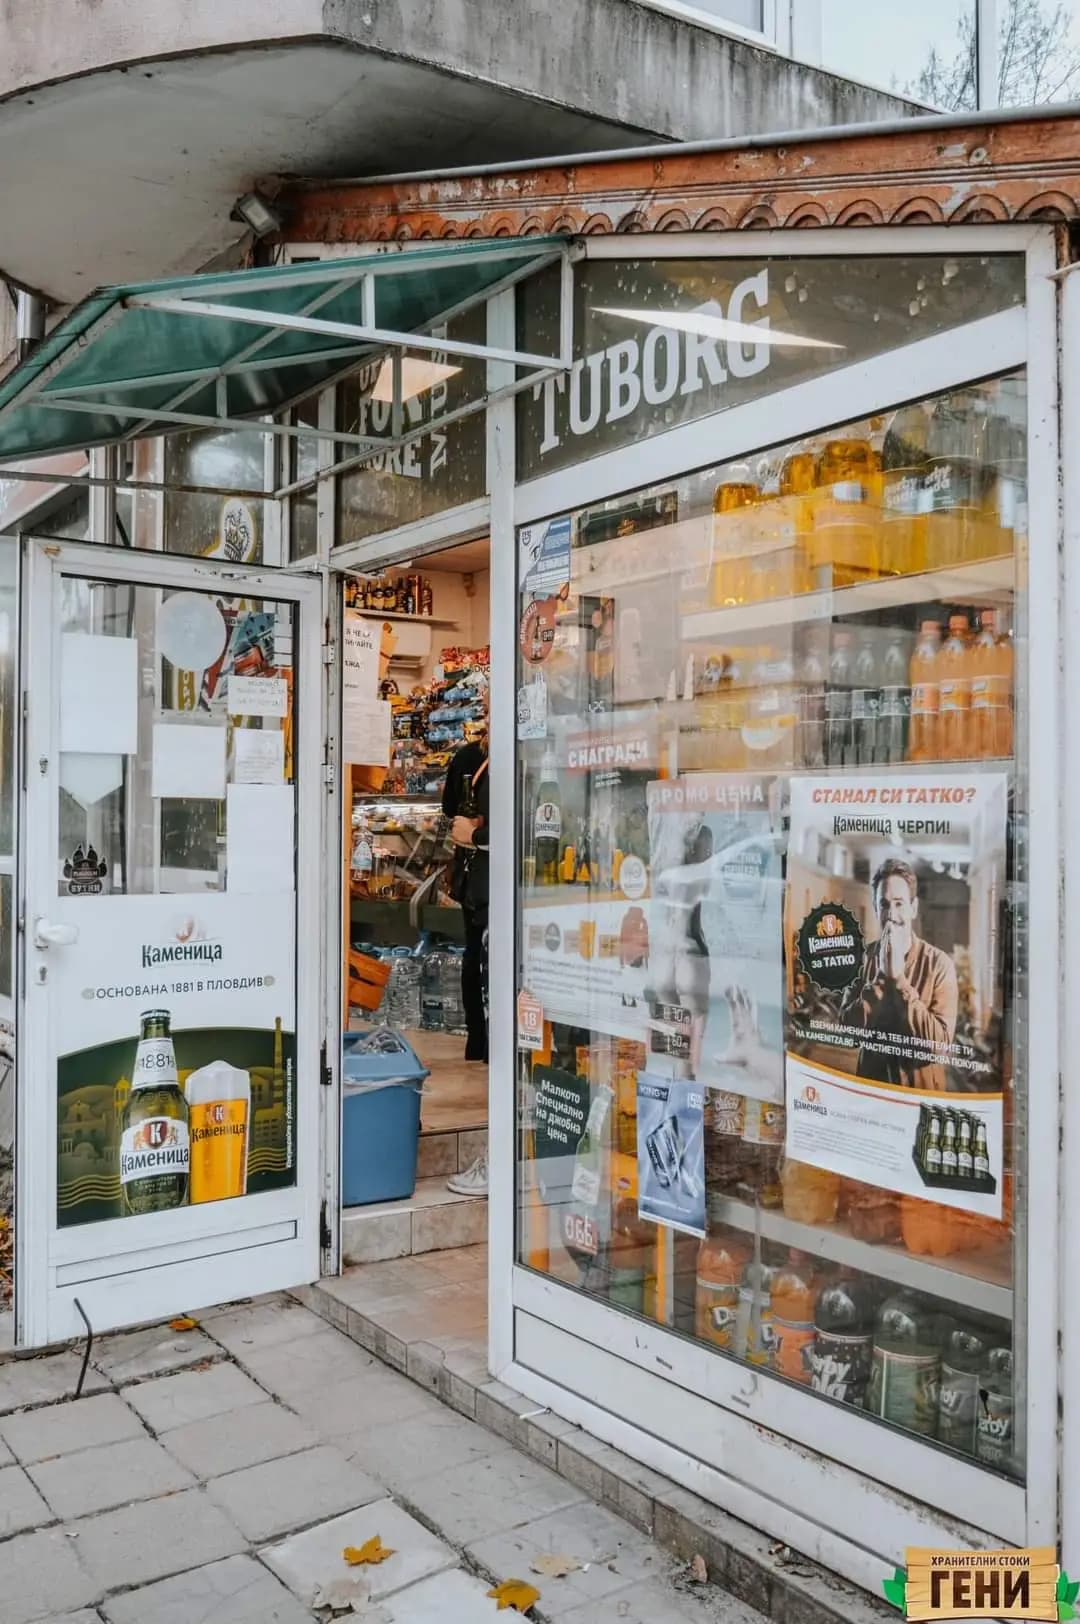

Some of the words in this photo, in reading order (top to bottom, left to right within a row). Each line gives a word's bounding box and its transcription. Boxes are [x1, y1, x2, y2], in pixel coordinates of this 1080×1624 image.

[533, 269, 771, 455] TUBORG
[812, 788, 877, 804] СТАНАЛ
[879, 788, 904, 804] СИ
[904, 787, 977, 804] ТАТКО?
[833, 815, 892, 836] Каменица
[897, 820, 951, 834] ЧЕРПИ!
[142, 943, 223, 968] Каменица
[808, 934, 855, 954] Каменица
[811, 959, 823, 969] за
[823, 954, 855, 968] ТАТКО
[96, 985, 168, 1000] ОСНОВАНА
[170, 982, 195, 993] 1881
[197, 981, 204, 992] В
[206, 976, 263, 991] ПЛОВДИВ
[795, 1029, 805, 1038] НА
[858, 1042, 901, 1057] УЧАСТИЕТО
[902, 1049, 912, 1058] НЕ
[913, 1050, 950, 1065] ИЗИСКВА
[876, 1032, 887, 1041] ЗА
[887, 1033, 902, 1043] ТЕБ
[902, 1036, 909, 1044] И
[962, 1047, 973, 1057] ТИ
[142, 1053, 171, 1069] 1881
[541, 1079, 581, 1104] Малкото
[535, 1091, 584, 1120] Специално
[793, 1098, 828, 1116] Каменица
[191, 1123, 245, 1143] Каменица
[535, 1108, 547, 1119] на
[547, 1112, 582, 1136] джобна
[547, 1128, 568, 1145] цена
[121, 1148, 189, 1176] Каменица
